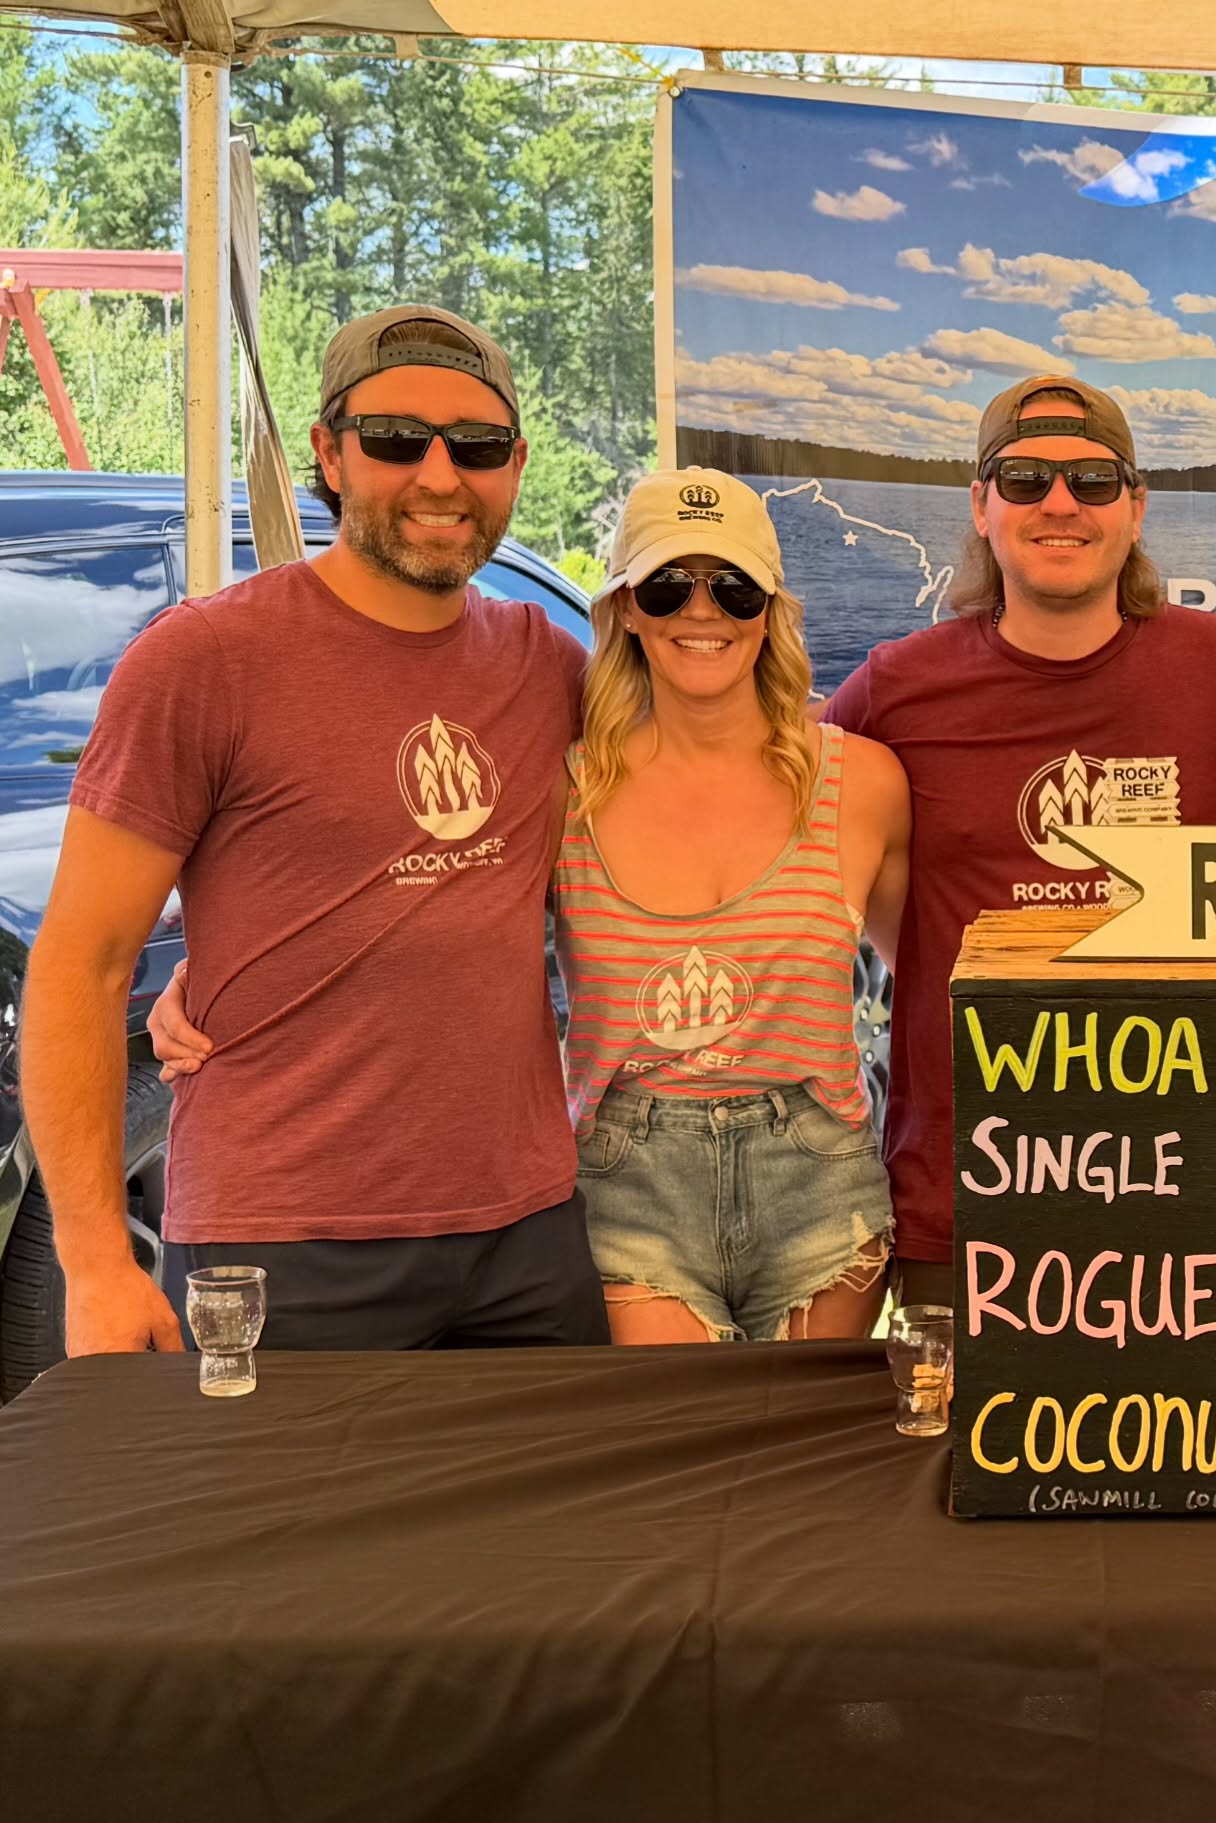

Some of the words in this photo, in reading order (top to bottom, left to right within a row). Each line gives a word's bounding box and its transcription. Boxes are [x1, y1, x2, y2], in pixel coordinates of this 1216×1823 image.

[1113, 765, 1171, 781] ROCKY
[1122, 782, 1165, 797] REEF
[1012, 881, 1090, 902] ROCKY
[695, 1048, 745, 1069] REEF
[964, 1006, 1208, 1095] WHOA
[961, 1116, 1184, 1204] SINGLE
[1028, 1484, 1161, 1512] (SAWMILL
